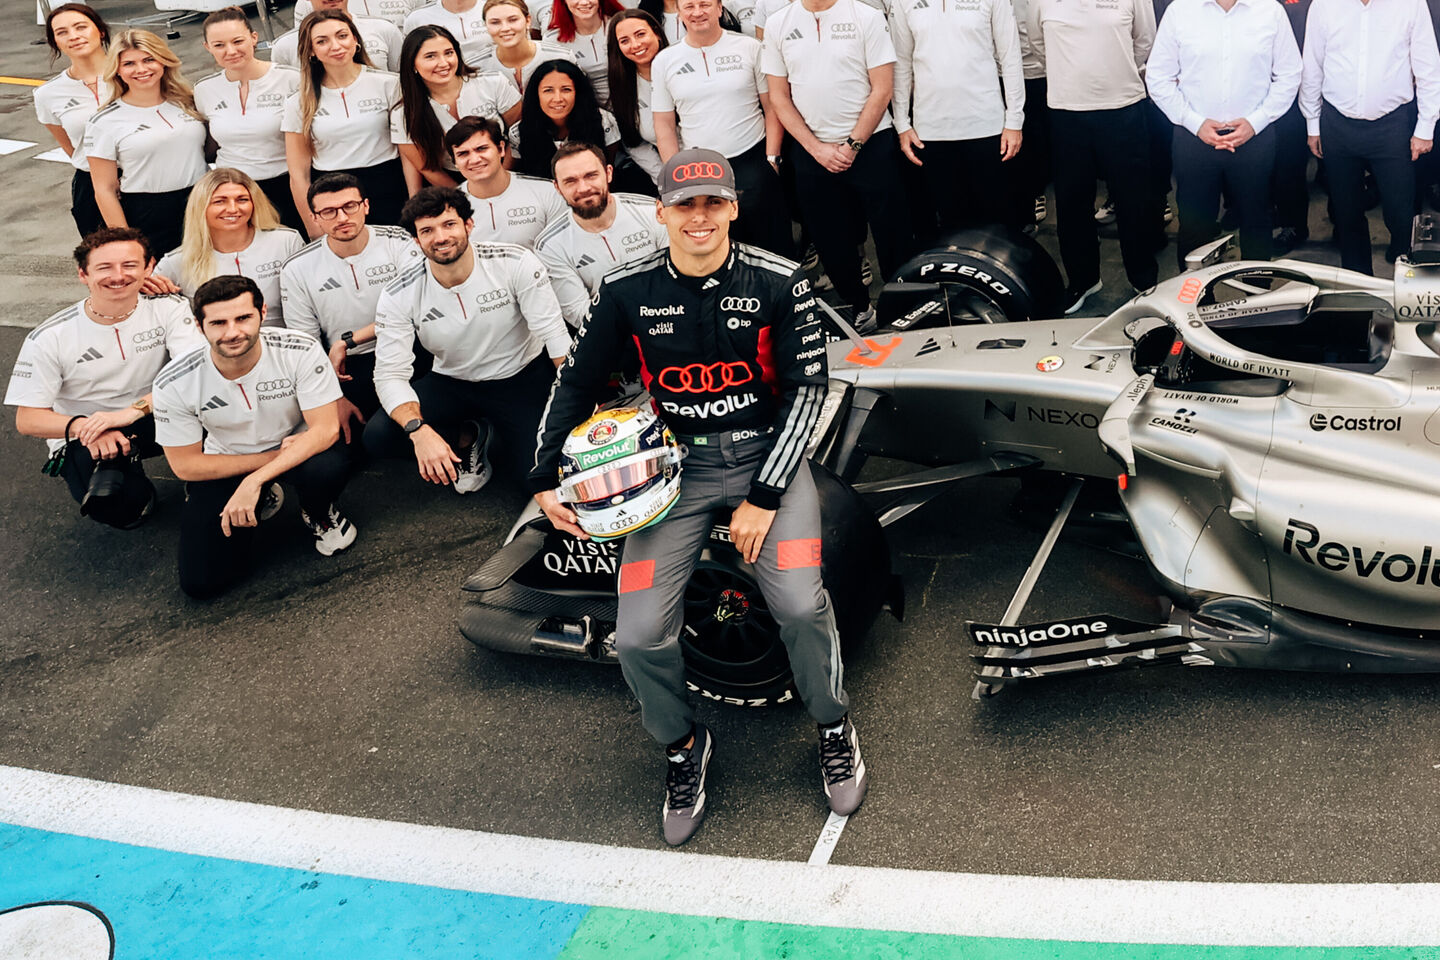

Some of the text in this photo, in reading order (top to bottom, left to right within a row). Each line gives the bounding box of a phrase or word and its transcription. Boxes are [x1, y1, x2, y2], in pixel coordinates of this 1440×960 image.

[508, 217, 537, 227] Revolut
[626, 239, 652, 254] Revolut
[920, 263, 1011, 295] P ZERO
[480, 298, 511, 314] Revolut
[640, 305, 684, 317] Revolut
[649, 327, 674, 335] QATAR
[740, 319, 751, 328] bp
[1105, 352, 1121, 374] NEXO
[1209, 353, 1291, 377] WORLD OF HYATT
[258, 390, 295, 402] Revolut
[1163, 392, 1239, 405] WORLD OF HYATT
[662, 393, 758, 419] Revolut
[1027, 407, 1099, 430] NEXO
[1151, 416, 1200, 436] CAMOZZI
[1329, 415, 1402, 431] Castrol
[583, 441, 630, 465] Revolut
[975, 620, 1108, 648] ninjaOne
